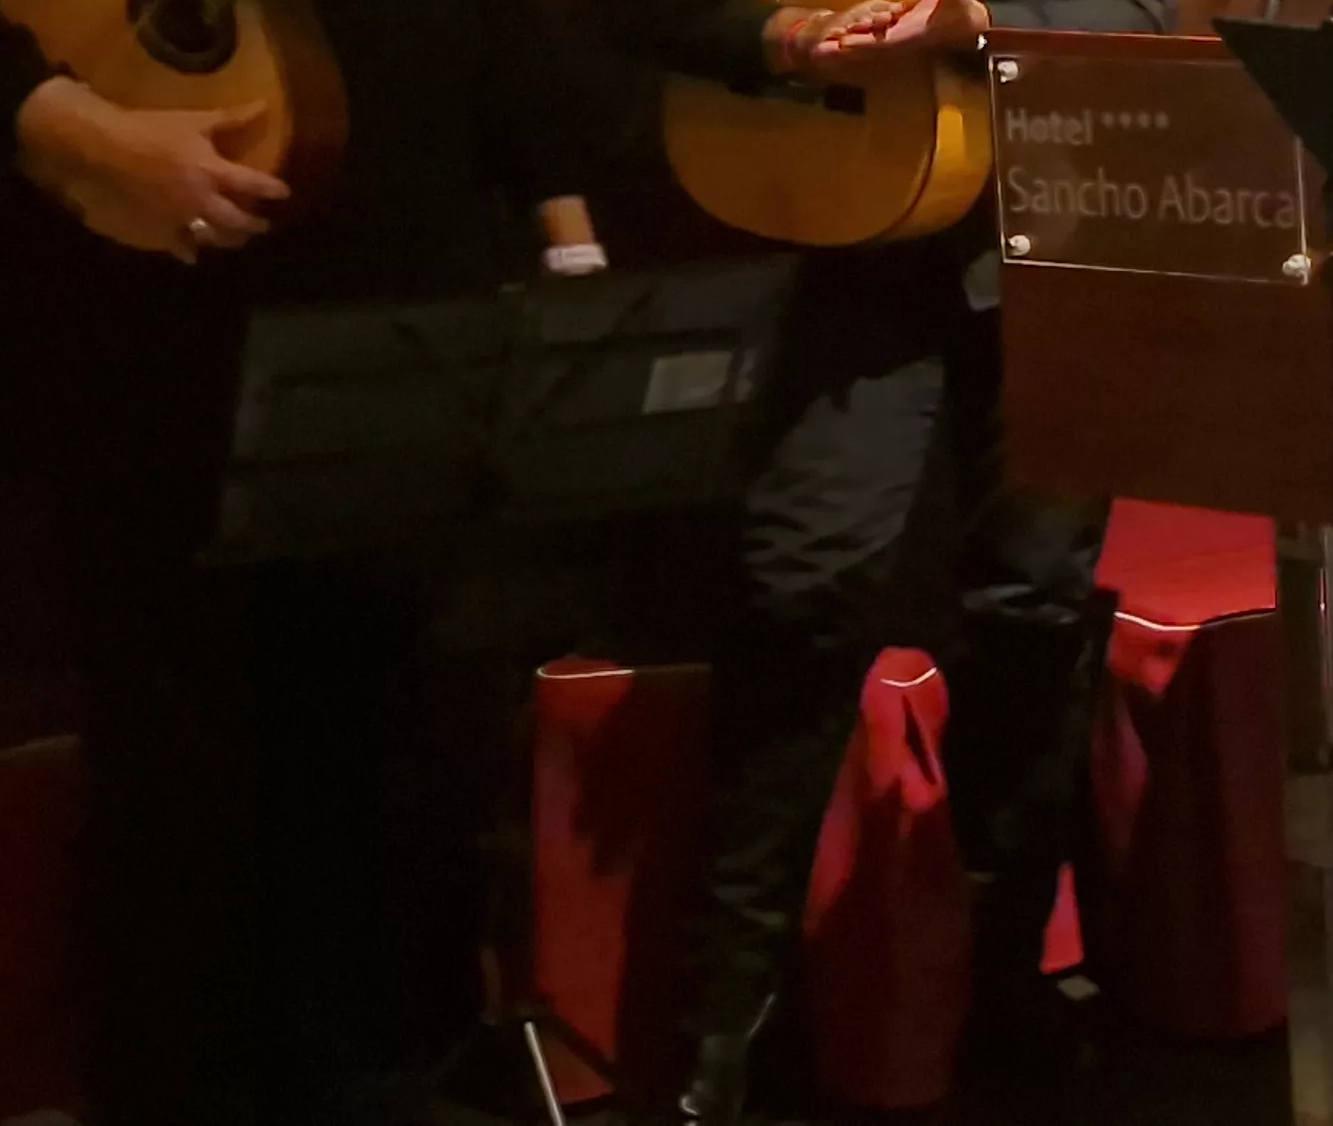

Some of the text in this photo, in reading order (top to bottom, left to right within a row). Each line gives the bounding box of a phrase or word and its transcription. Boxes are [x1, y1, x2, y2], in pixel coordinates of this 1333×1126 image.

[1004, 107, 1095, 146] Hotel
[1006, 164, 1297, 229] Sancho Abarca
